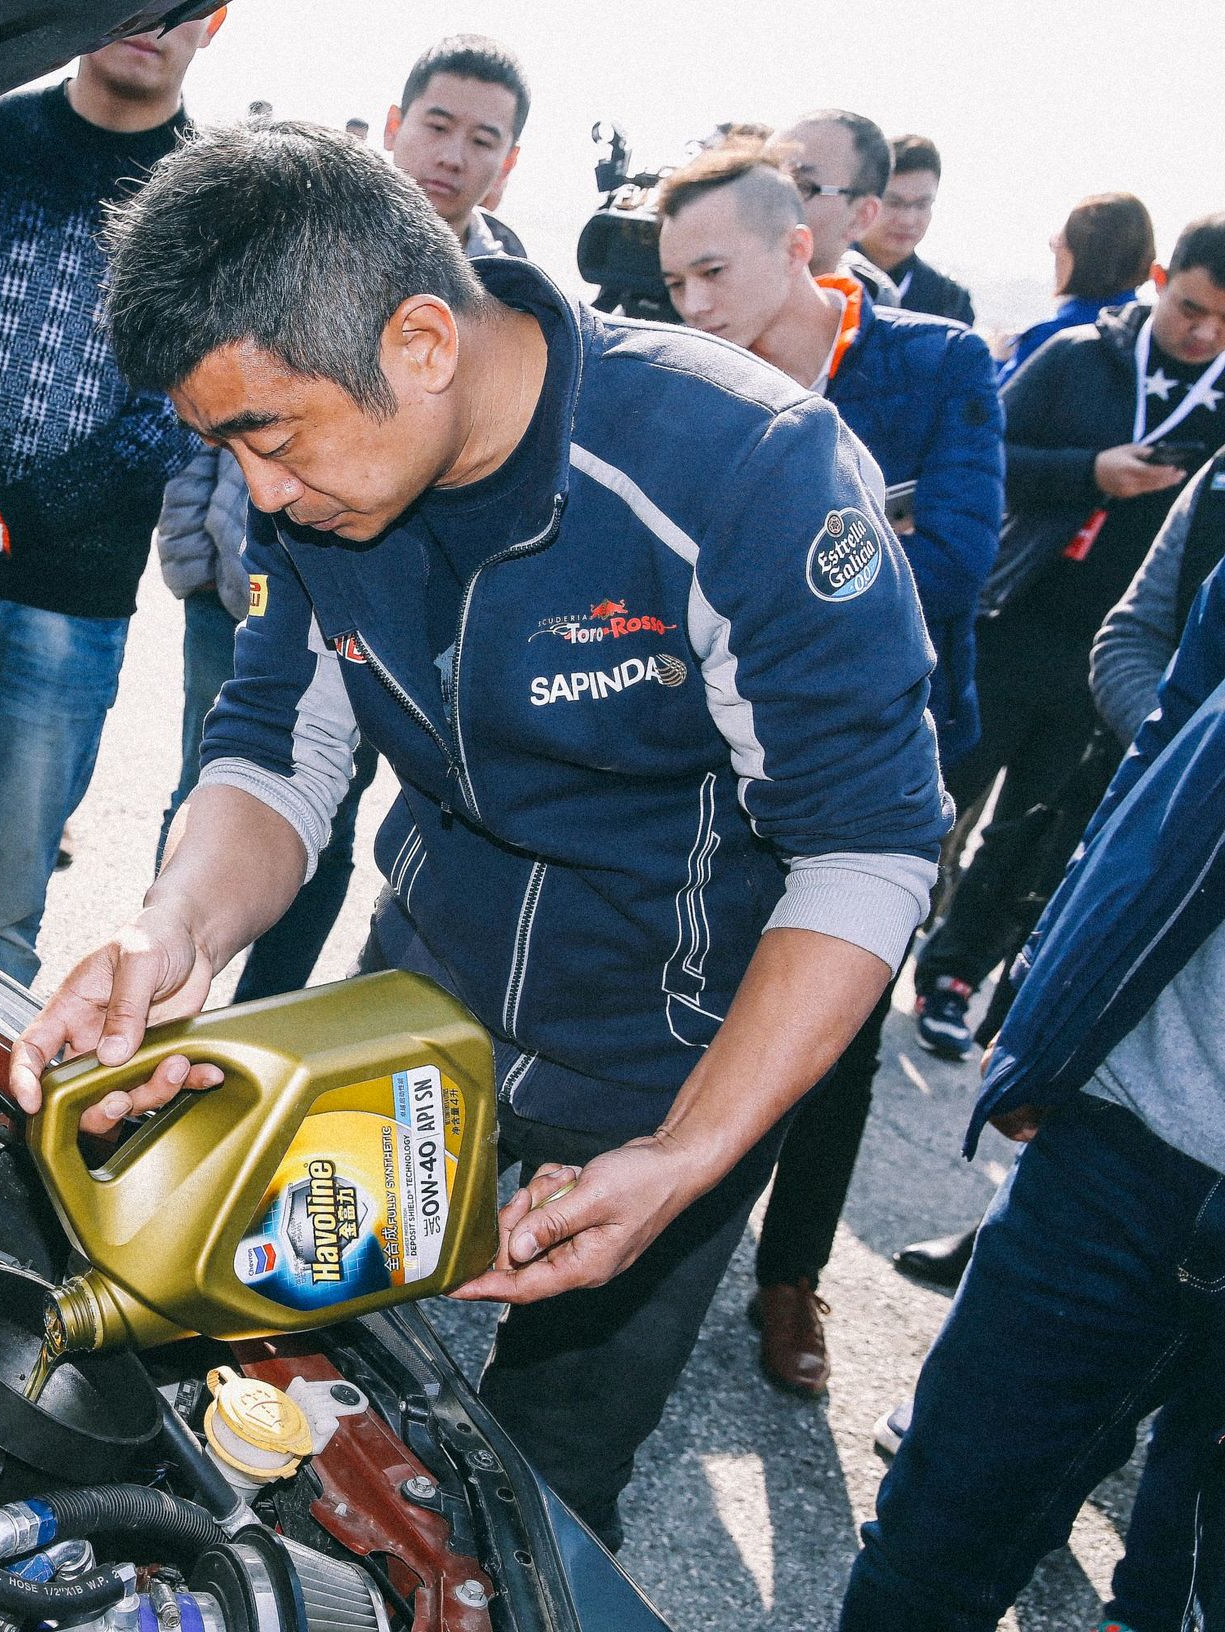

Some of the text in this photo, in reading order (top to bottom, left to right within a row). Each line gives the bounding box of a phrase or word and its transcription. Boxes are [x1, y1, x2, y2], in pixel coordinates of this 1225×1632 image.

[817, 520, 867, 575] Estrella
[829, 540, 876, 588] Galicia
[538, 614, 588, 627] SCUDERIA
[530, 656, 663, 706] SAPINDA
[403, 1135, 413, 1187] TECHNOLOGY
[414, 1078, 441, 1237] SAE 0W-40 API SN
[306, 1160, 341, 1286] Havoline
[337, 1187, 359, 1240] 金富力
[381, 1125, 400, 1272] 全合成 FULLY SYNTHETIC
[408, 1223, 417, 1256] DEPOSIT
[9, 1577, 39, 1593] HOSE
[86, 1576, 109, 1590] W.P.
